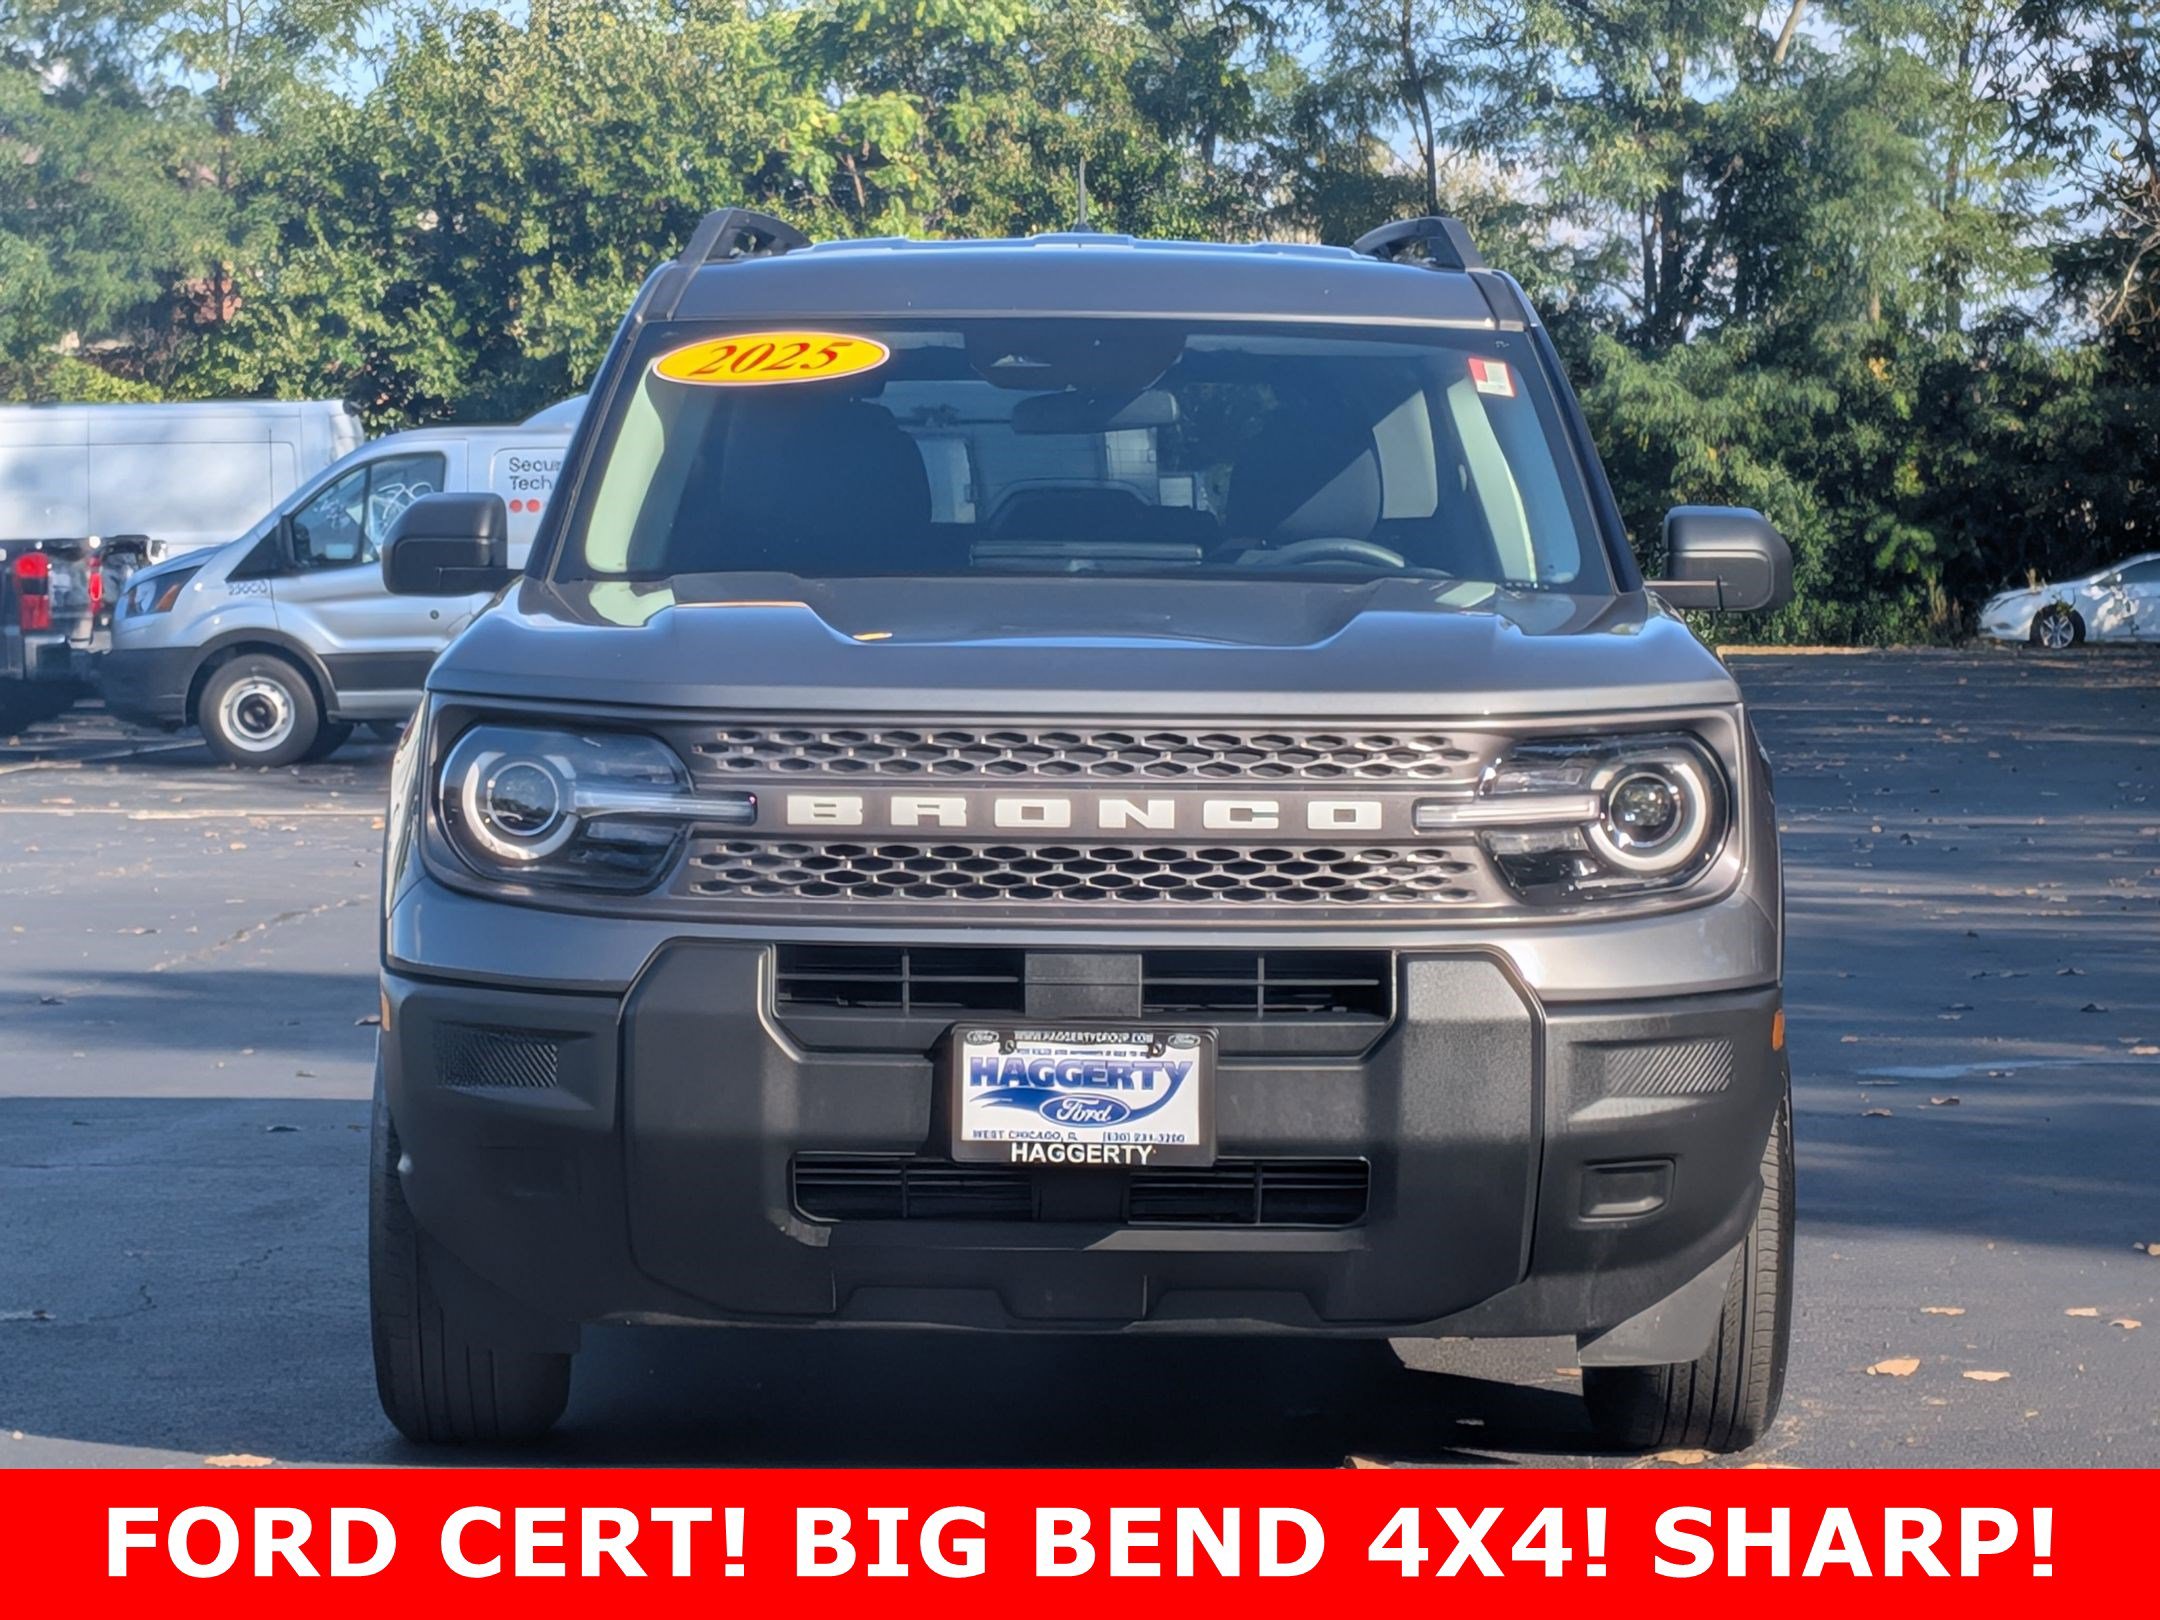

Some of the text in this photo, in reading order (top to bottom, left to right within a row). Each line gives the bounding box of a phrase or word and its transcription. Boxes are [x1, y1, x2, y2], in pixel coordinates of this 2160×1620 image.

[688, 342, 853, 376] 2025
[509, 475, 552, 490] Tech
[787, 796, 1382, 829] BRONCO
[970, 1057, 1193, 1090] HAGGERTY
[1056, 1098, 1113, 1122] Ford
[972, 1130, 1005, 1140] WEST
[1011, 1143, 1153, 1164] HAGGERTY
